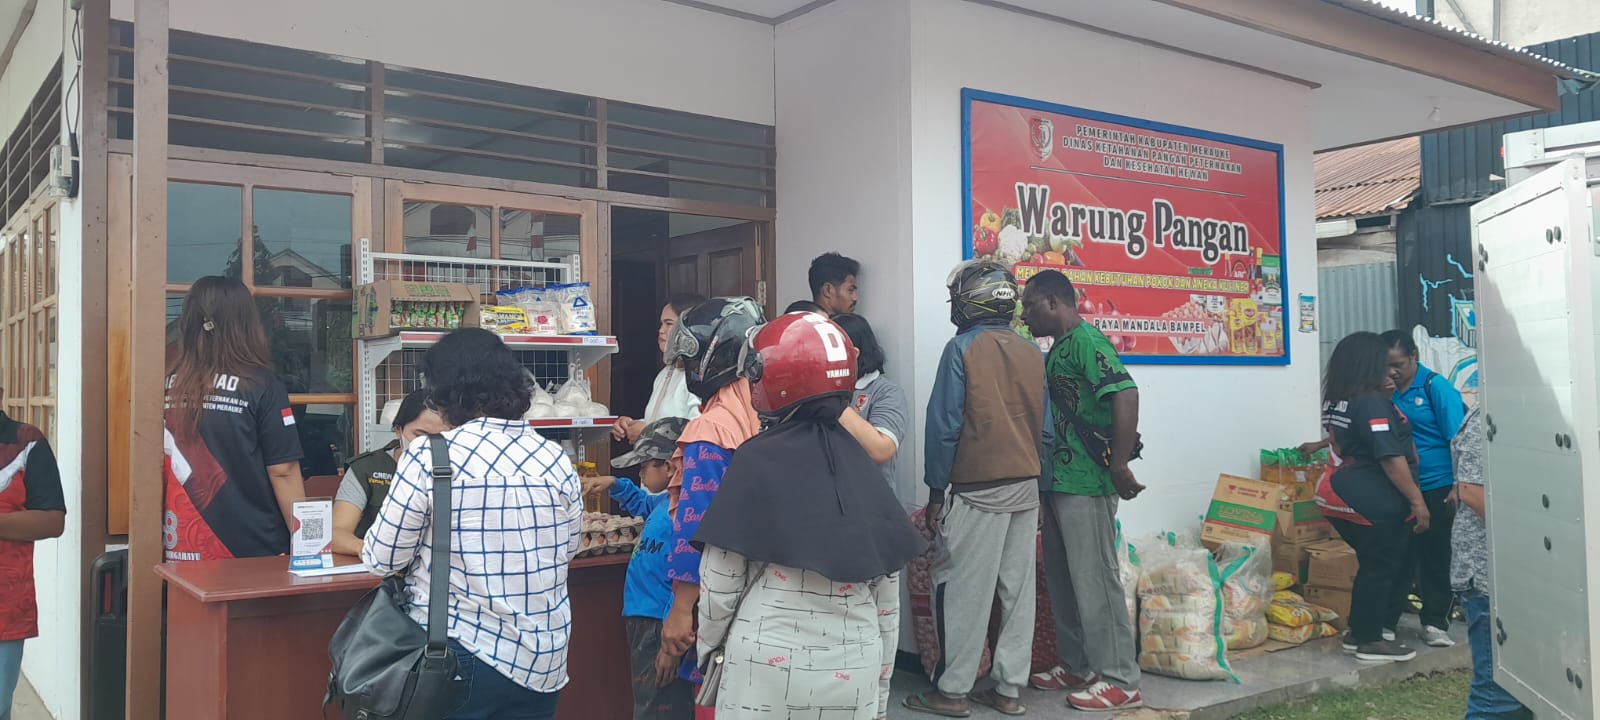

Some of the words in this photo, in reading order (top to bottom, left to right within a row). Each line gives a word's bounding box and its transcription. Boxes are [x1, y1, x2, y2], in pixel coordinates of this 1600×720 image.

[1076, 125, 1136, 144] PEMERINTAH
[1138, 135, 1189, 153] KABUPATEN
[1191, 144, 1230, 160] MERAUKE
[1063, 137, 1093, 151] DINAS
[1095, 142, 1150, 159] KETAHANAN
[1151, 151, 1187, 165] PANGAN
[1189, 157, 1242, 174] PETERNAKAN
[1104, 156, 1123, 168] DAN
[1124, 160, 1176, 176] KESEHATAN
[1178, 168, 1208, 181] HEWAN
[1016, 184, 1145, 257] Warung
[1153, 200, 1248, 262] Pangan
[1094, 271, 1145, 287] KEBUTUHAN
[1146, 275, 1174, 289] POKOK
[1174, 277, 1191, 289] DAN
[1192, 278, 1217, 291] ANEKA
[1219, 280, 1249, 293] KULINER
[1094, 319, 1119, 331] RAYA
[1122, 320, 1168, 332] MANDALA
[1170, 321, 1206, 333] BAMPEL
[826, 368, 850, 378] YAMAHA
[216, 404, 243, 414] MERAUKE
[691, 476, 719, 492] Barbie
